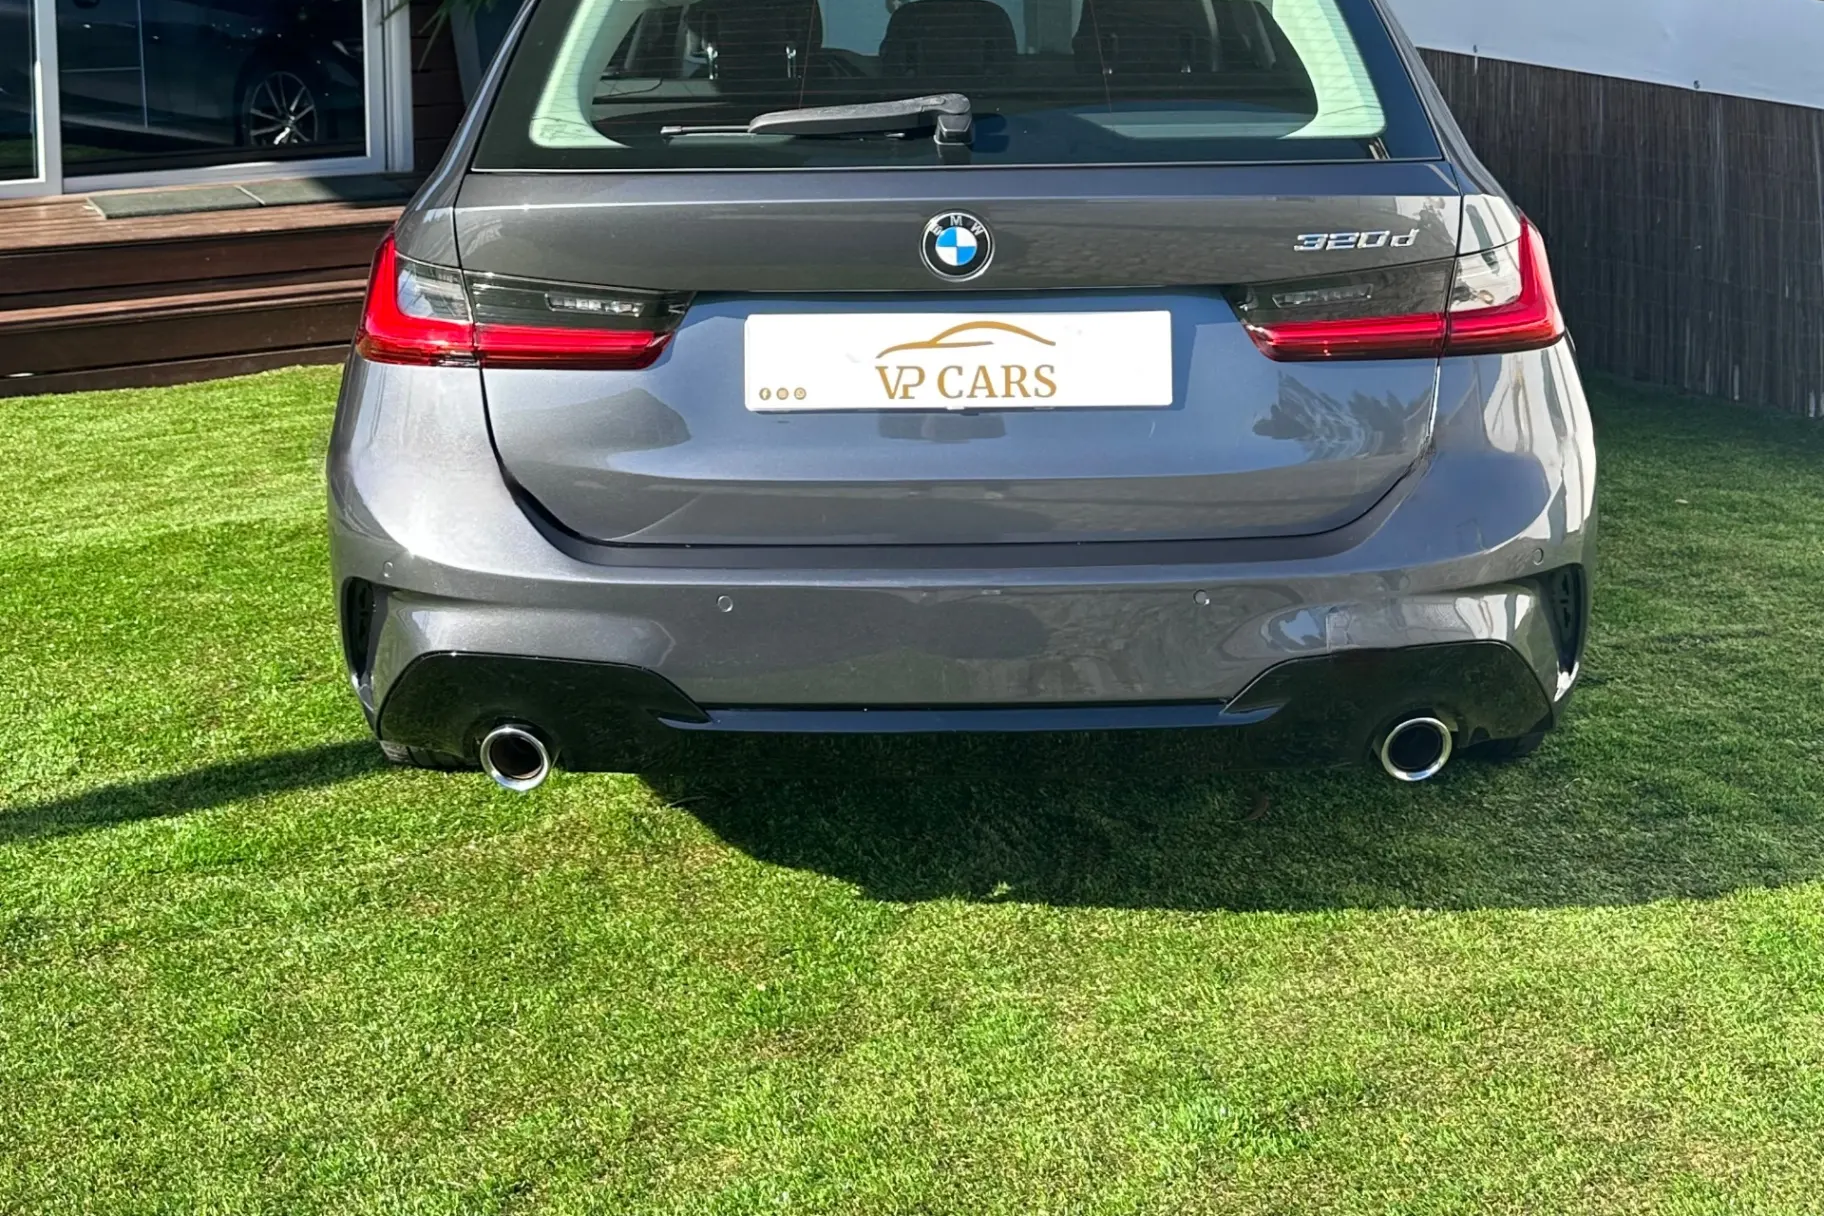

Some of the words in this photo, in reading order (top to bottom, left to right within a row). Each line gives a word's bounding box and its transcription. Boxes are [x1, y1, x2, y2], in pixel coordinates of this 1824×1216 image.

[929, 215, 984, 237] BMW
[1293, 228, 1420, 252] 320d
[875, 365, 925, 400] VP
[937, 364, 1057, 400] CARS
